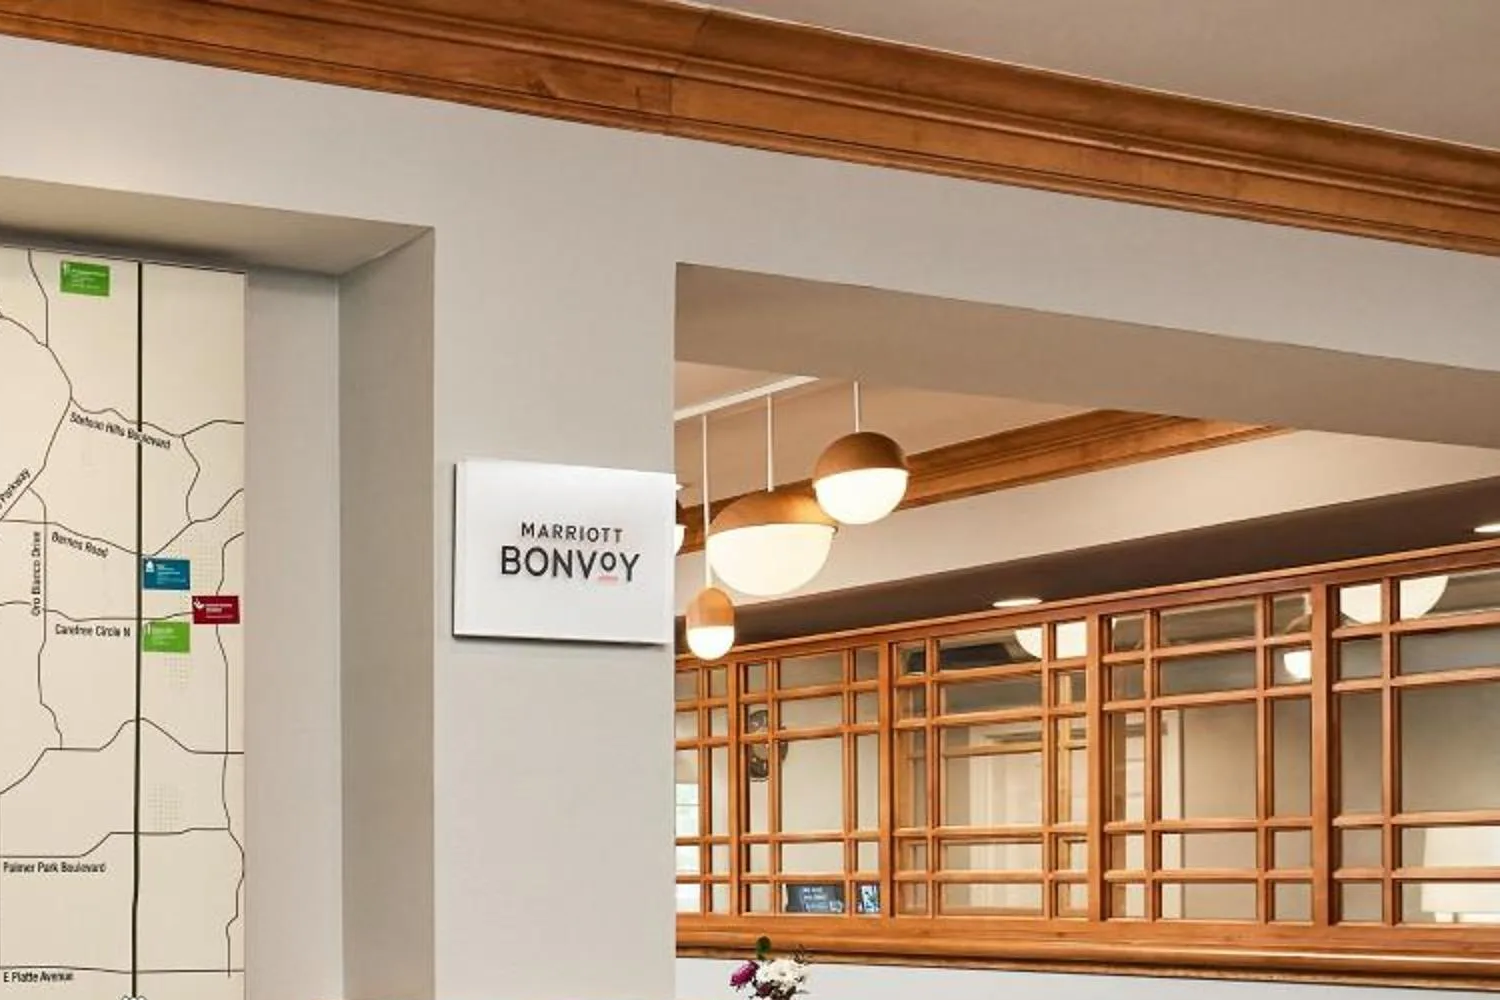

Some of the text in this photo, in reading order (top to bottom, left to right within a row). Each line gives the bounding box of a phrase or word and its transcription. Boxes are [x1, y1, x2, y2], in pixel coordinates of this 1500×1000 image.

[521, 522, 623, 543] MARRIOTT
[501, 545, 640, 582] BONVOY
[3, 862, 107, 873] Palmer Park Boulevard
[3, 971, 73, 983] E Platte Avenue
